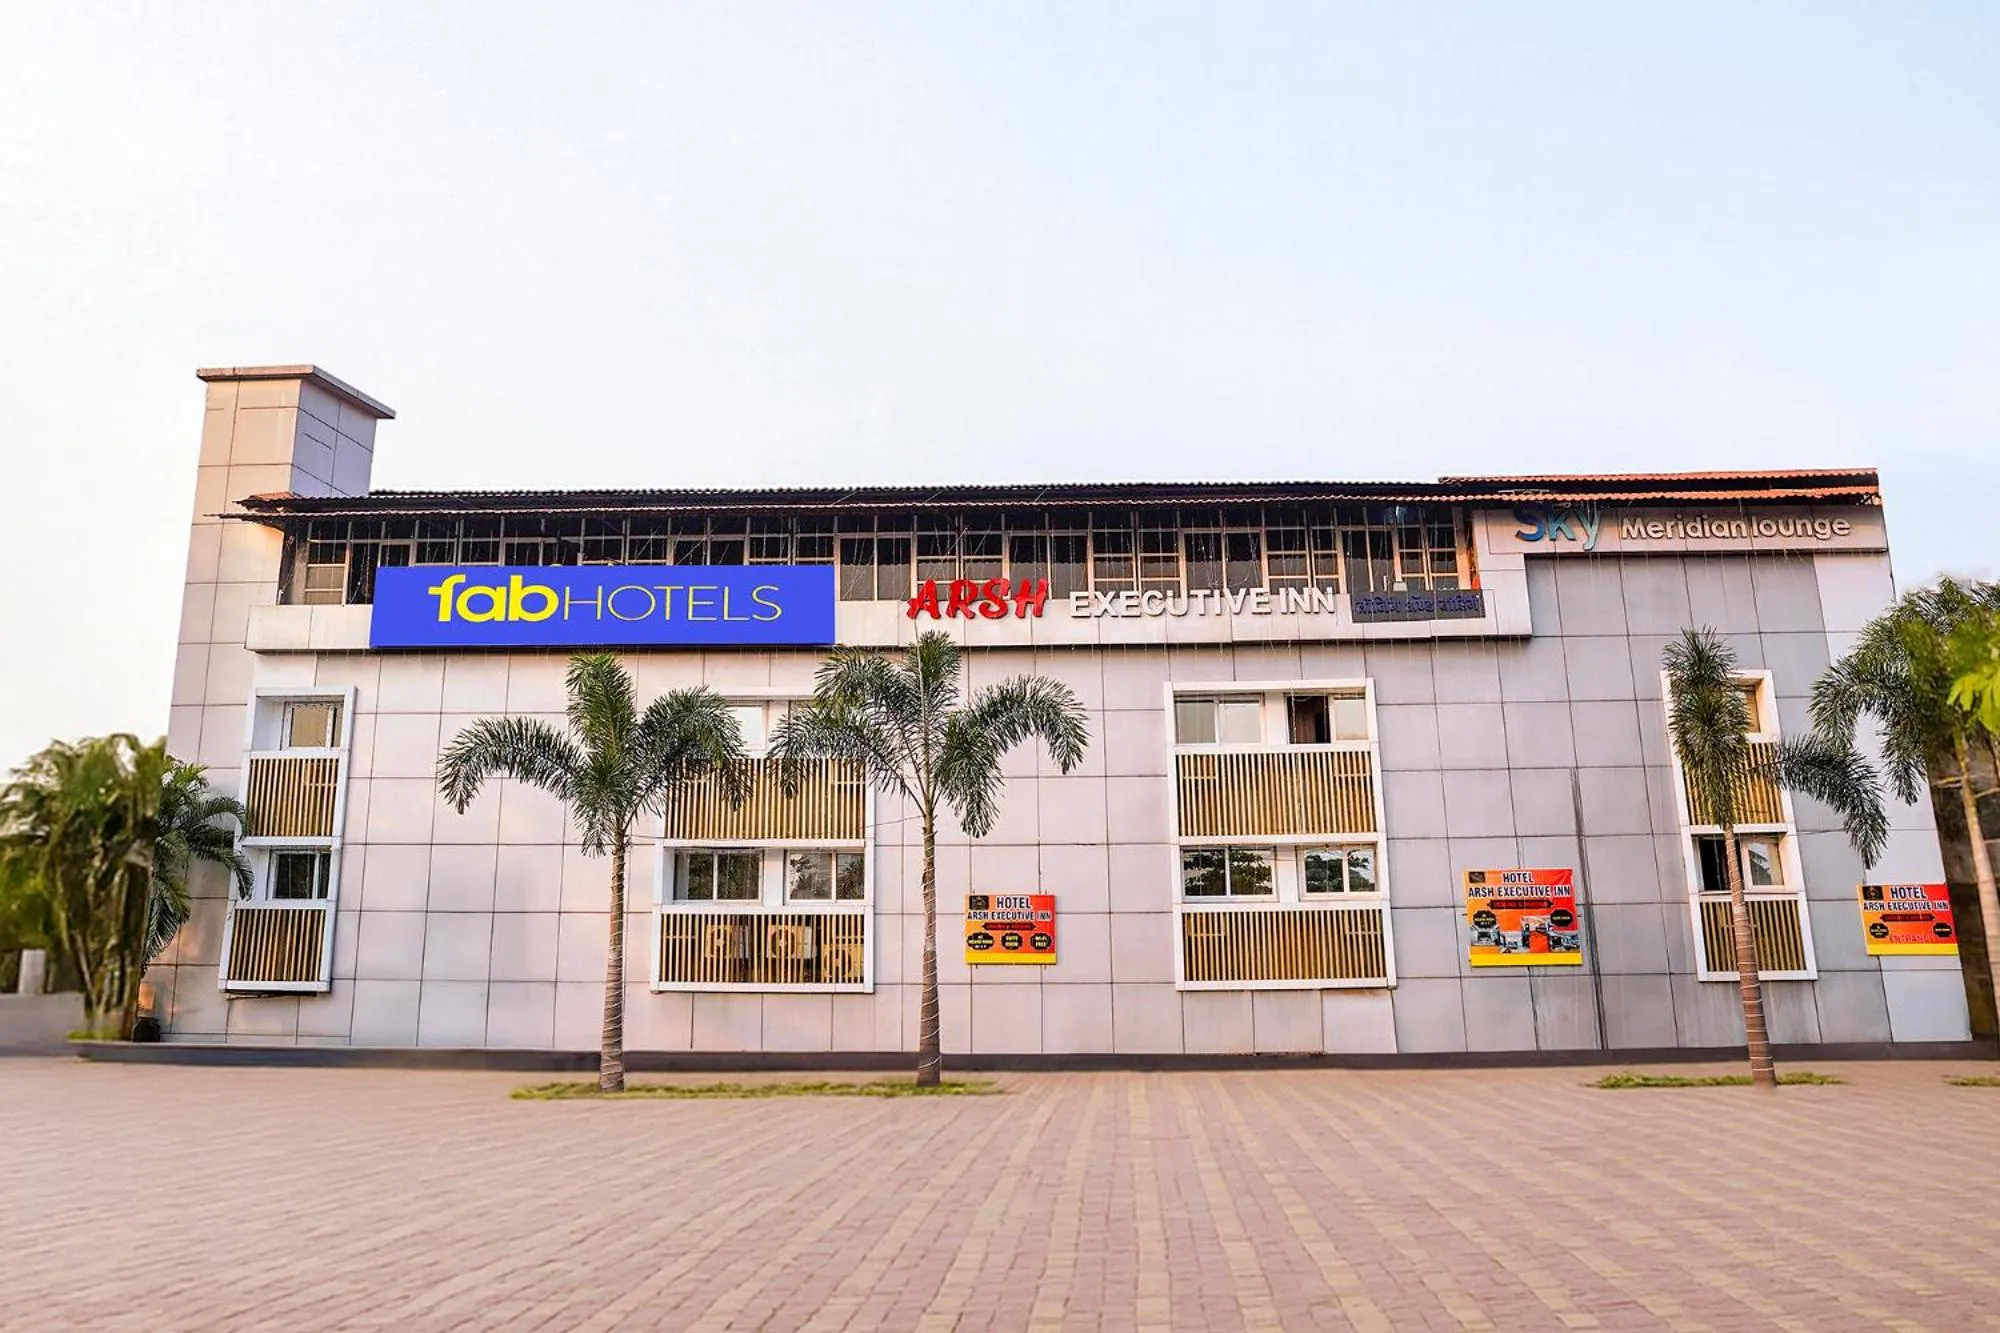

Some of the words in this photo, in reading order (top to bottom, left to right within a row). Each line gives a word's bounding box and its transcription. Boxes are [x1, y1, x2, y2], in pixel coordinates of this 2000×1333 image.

[1514, 503, 1601, 550] Sky
[1621, 513, 1748, 539] Meridian
[1751, 515, 1850, 539] lounge
[906, 577, 1050, 620] ARSH
[1069, 586, 1272, 618] EXECUTIVE
[1279, 585, 1336, 615] INN
[1503, 872, 1534, 883] HOTEL
[1468, 886, 1494, 897] ARSH
[1497, 886, 1551, 897] EXECUTIVE
[1554, 885, 1571, 896] INN
[1890, 887, 1927, 899] HOTEL
[996, 896, 1032, 909] HOTEL
[1863, 901, 1885, 911] ARSH
[1888, 901, 1931, 911] EXECUTIVE
[1934, 901, 1949, 910] INN
[967, 911, 989, 920] ARSH
[991, 911, 1034, 920] EXECUTIVE
[1036, 911, 1051, 920] INN
